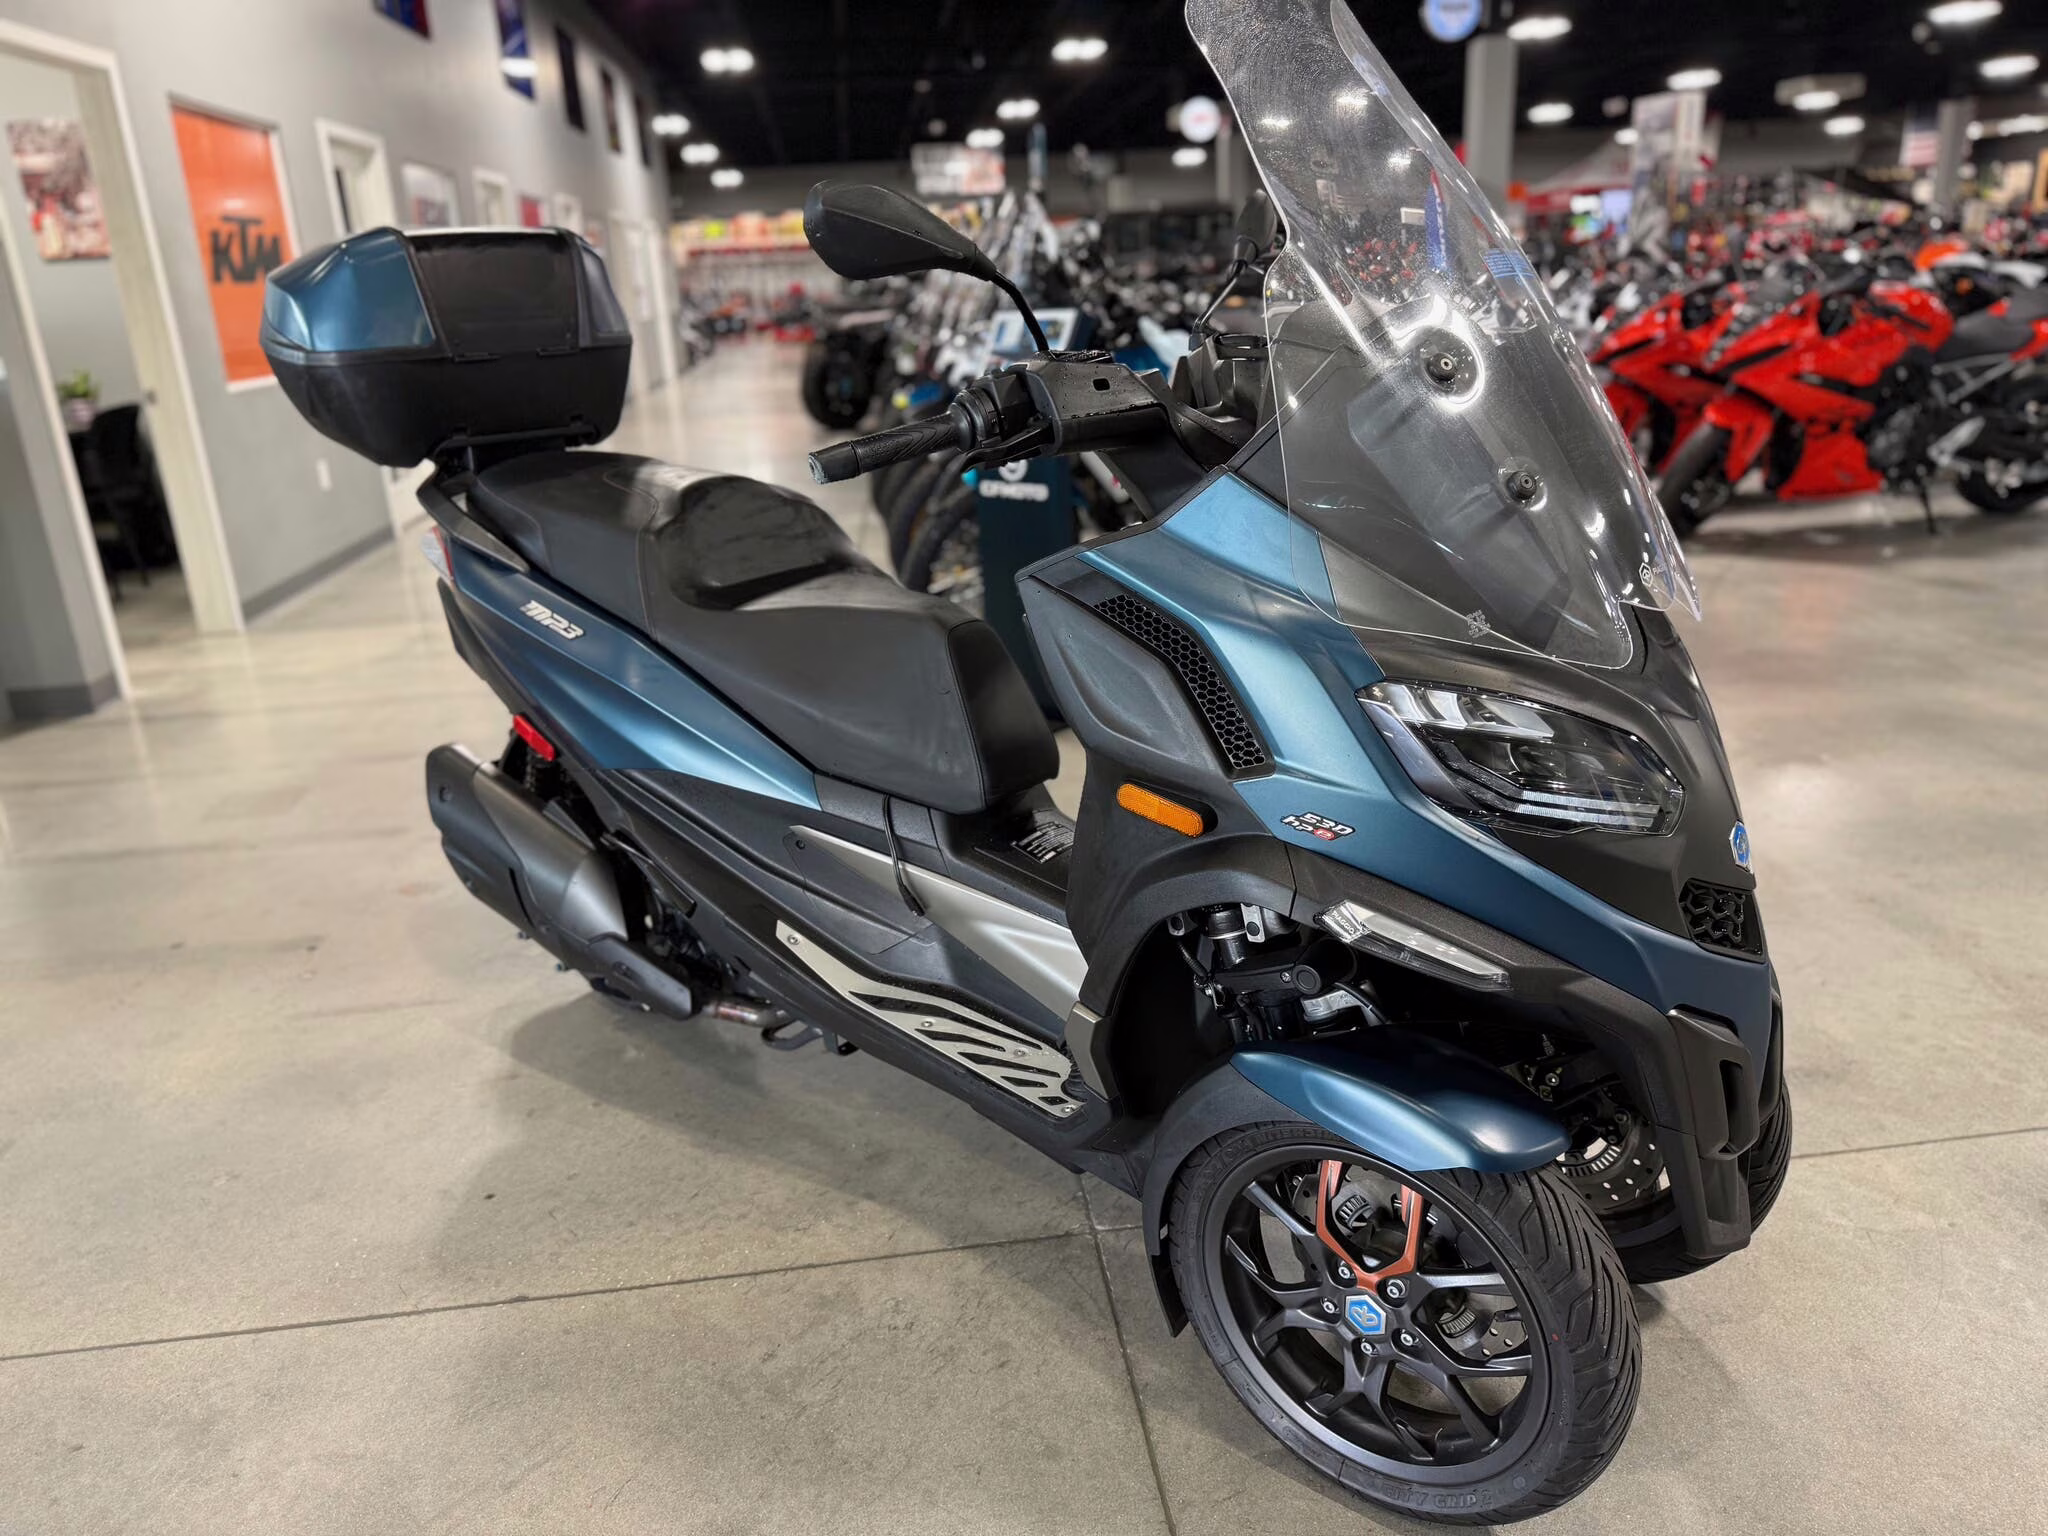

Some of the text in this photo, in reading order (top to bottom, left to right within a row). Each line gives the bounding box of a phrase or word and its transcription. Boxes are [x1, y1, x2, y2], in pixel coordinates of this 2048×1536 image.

[211, 215, 281, 283] KTM
[519, 599, 584, 639] MP3
[1300, 813, 1354, 835] 530
[1331, 909, 1355, 935] PIAGGIO
[1433, 1493, 1477, 1509] GRIP
